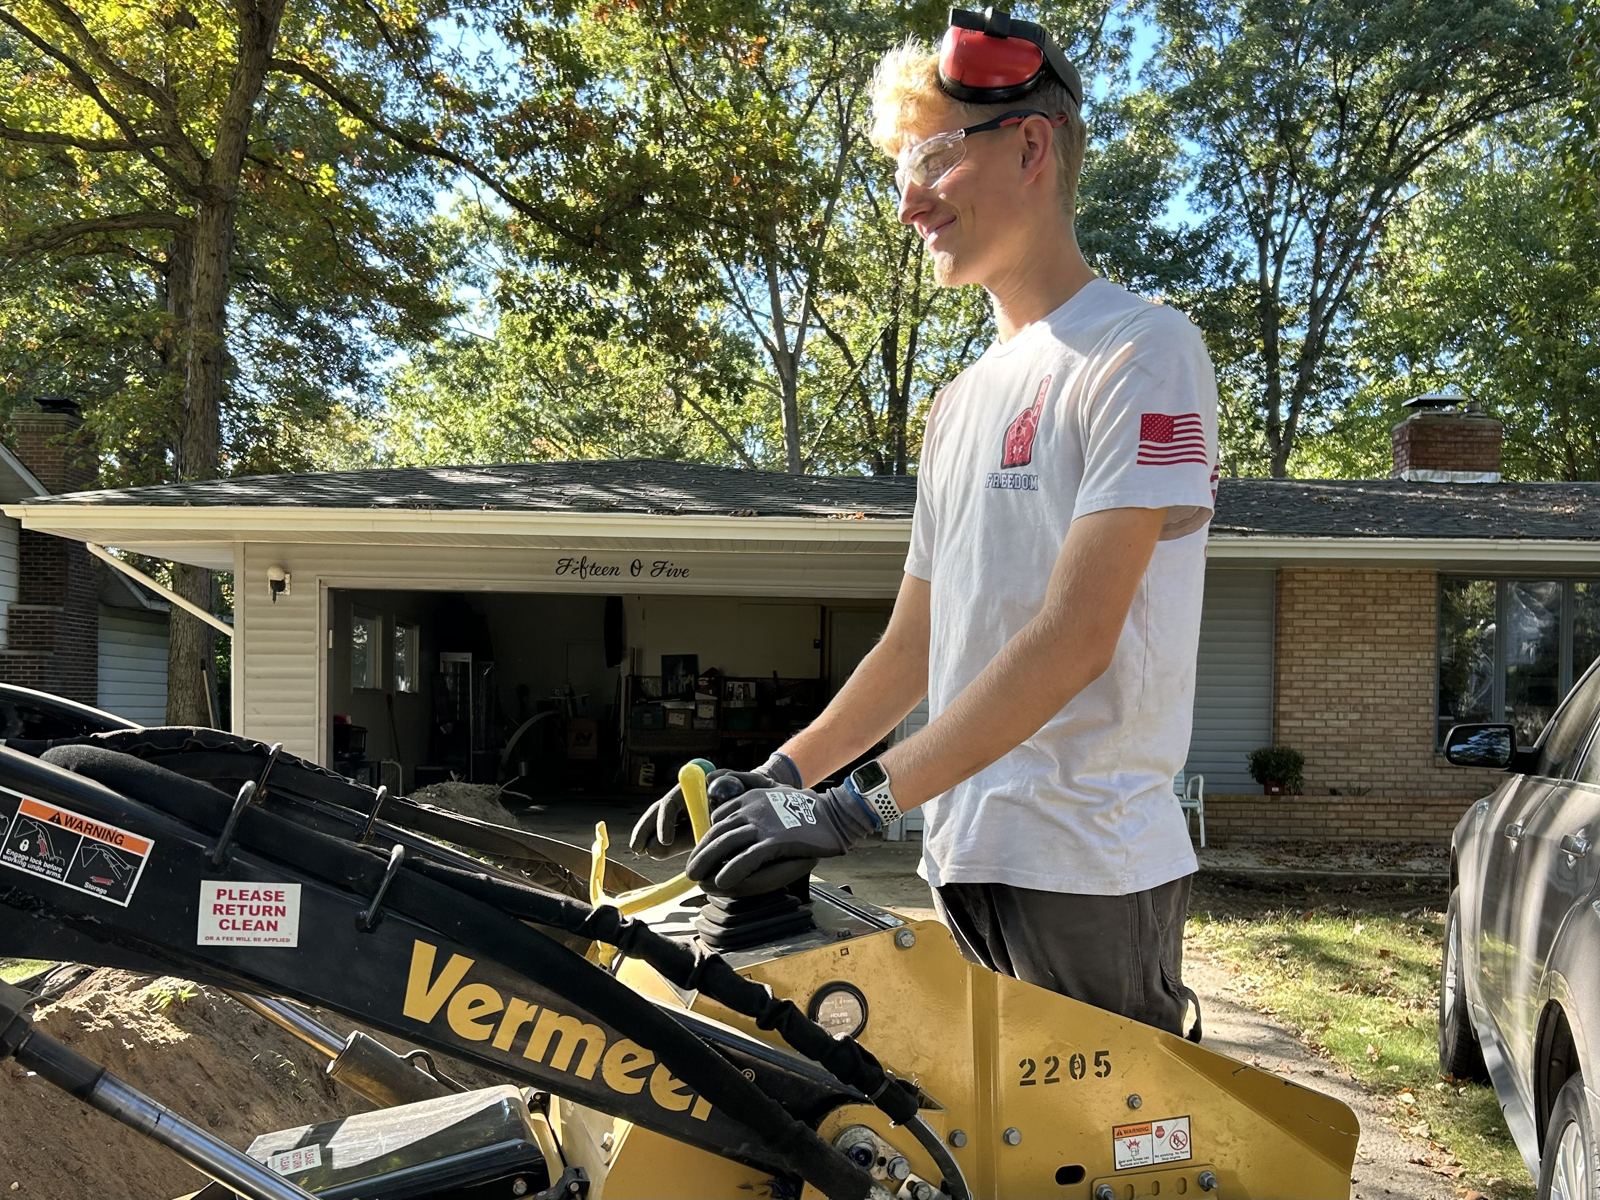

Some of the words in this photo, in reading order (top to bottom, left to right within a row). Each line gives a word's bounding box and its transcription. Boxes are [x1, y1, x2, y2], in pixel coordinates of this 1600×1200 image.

[985, 472, 1038, 491] FREEDOM
[555, 555, 621, 580] Fifteen
[650, 560, 690, 578] Five
[64, 815, 125, 846] WARNING
[3, 854, 27, 868] working
[27, 863, 45, 873] under
[46, 869, 63, 879] arms.
[6, 848, 29, 862] Engage
[29, 856, 42, 866] lock
[43, 861, 63, 873] before
[84, 881, 108, 895] Storage
[216, 888, 285, 902] PLEASE
[212, 903, 287, 917] RETURN
[218, 918, 279, 932] CLEAN
[1018, 1050, 1112, 1087] 2205
[1123, 1126, 1150, 1135] WARNING
